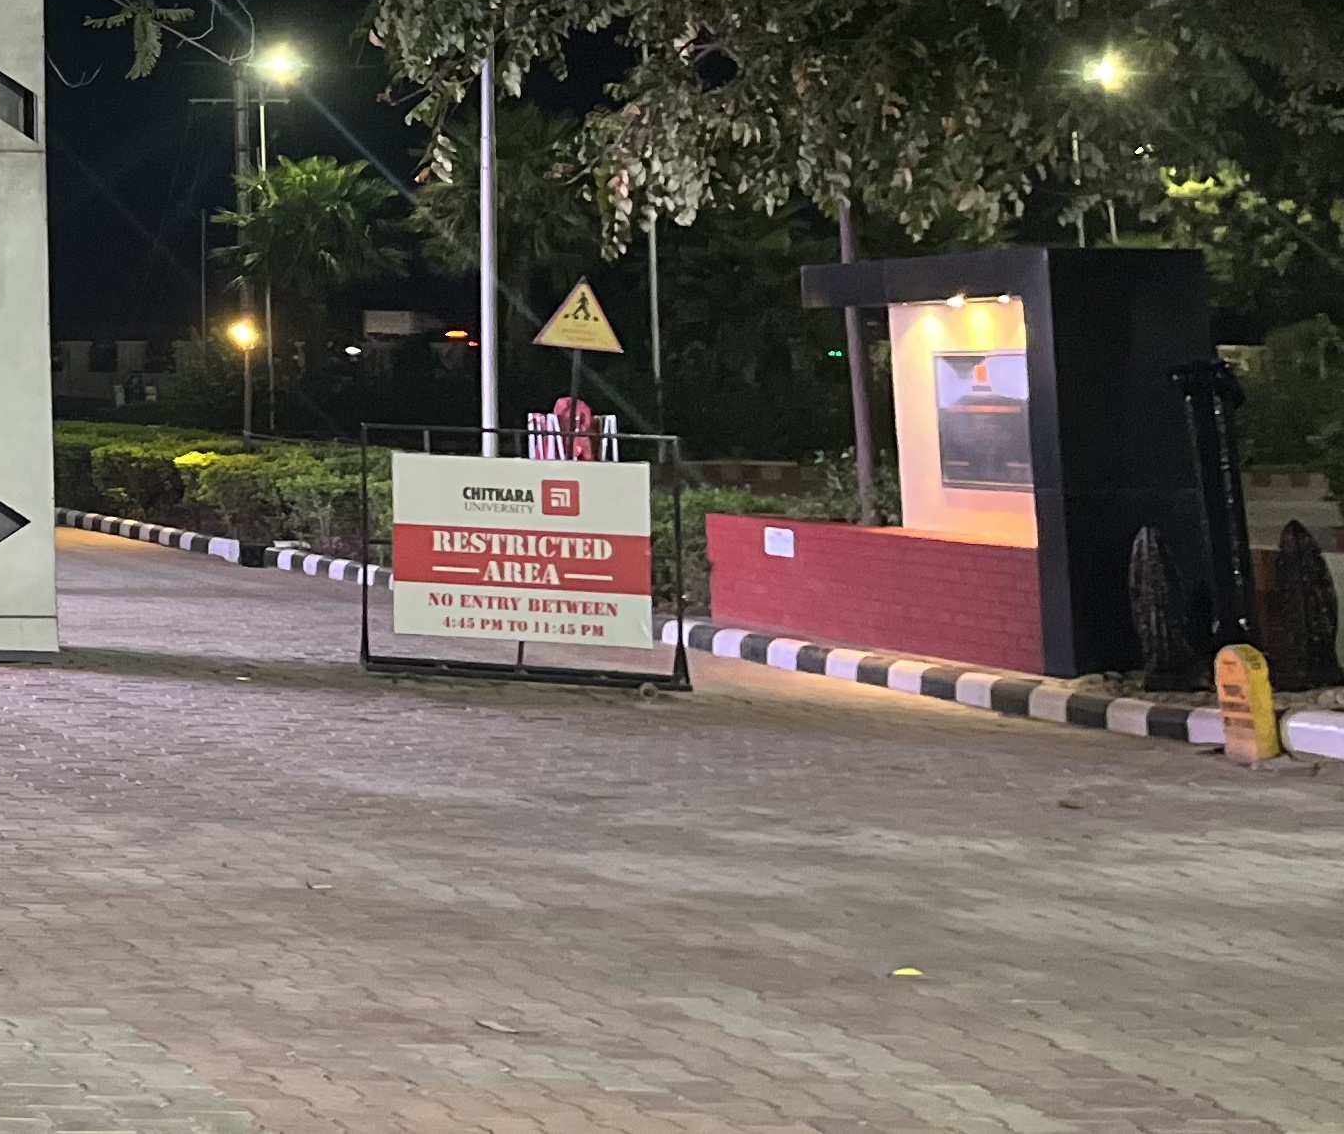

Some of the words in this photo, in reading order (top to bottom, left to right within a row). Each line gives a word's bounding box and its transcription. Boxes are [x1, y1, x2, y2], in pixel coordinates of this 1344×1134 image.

[462, 486, 534, 503] CHITKARA
[464, 501, 534, 514] UNIVERSITY
[432, 530, 613, 561] RESTRICTED
[482, 560, 561, 586] AREA
[428, 592, 454, 607] NO
[460, 594, 522, 612] ENTRY
[527, 597, 619, 618] BETWEEN
[442, 616, 476, 630] 4:45
[480, 618, 504, 632] PM
[507, 619, 528, 633] TO
[533, 621, 577, 636] 11:45
[581, 624, 605, 637] PM
